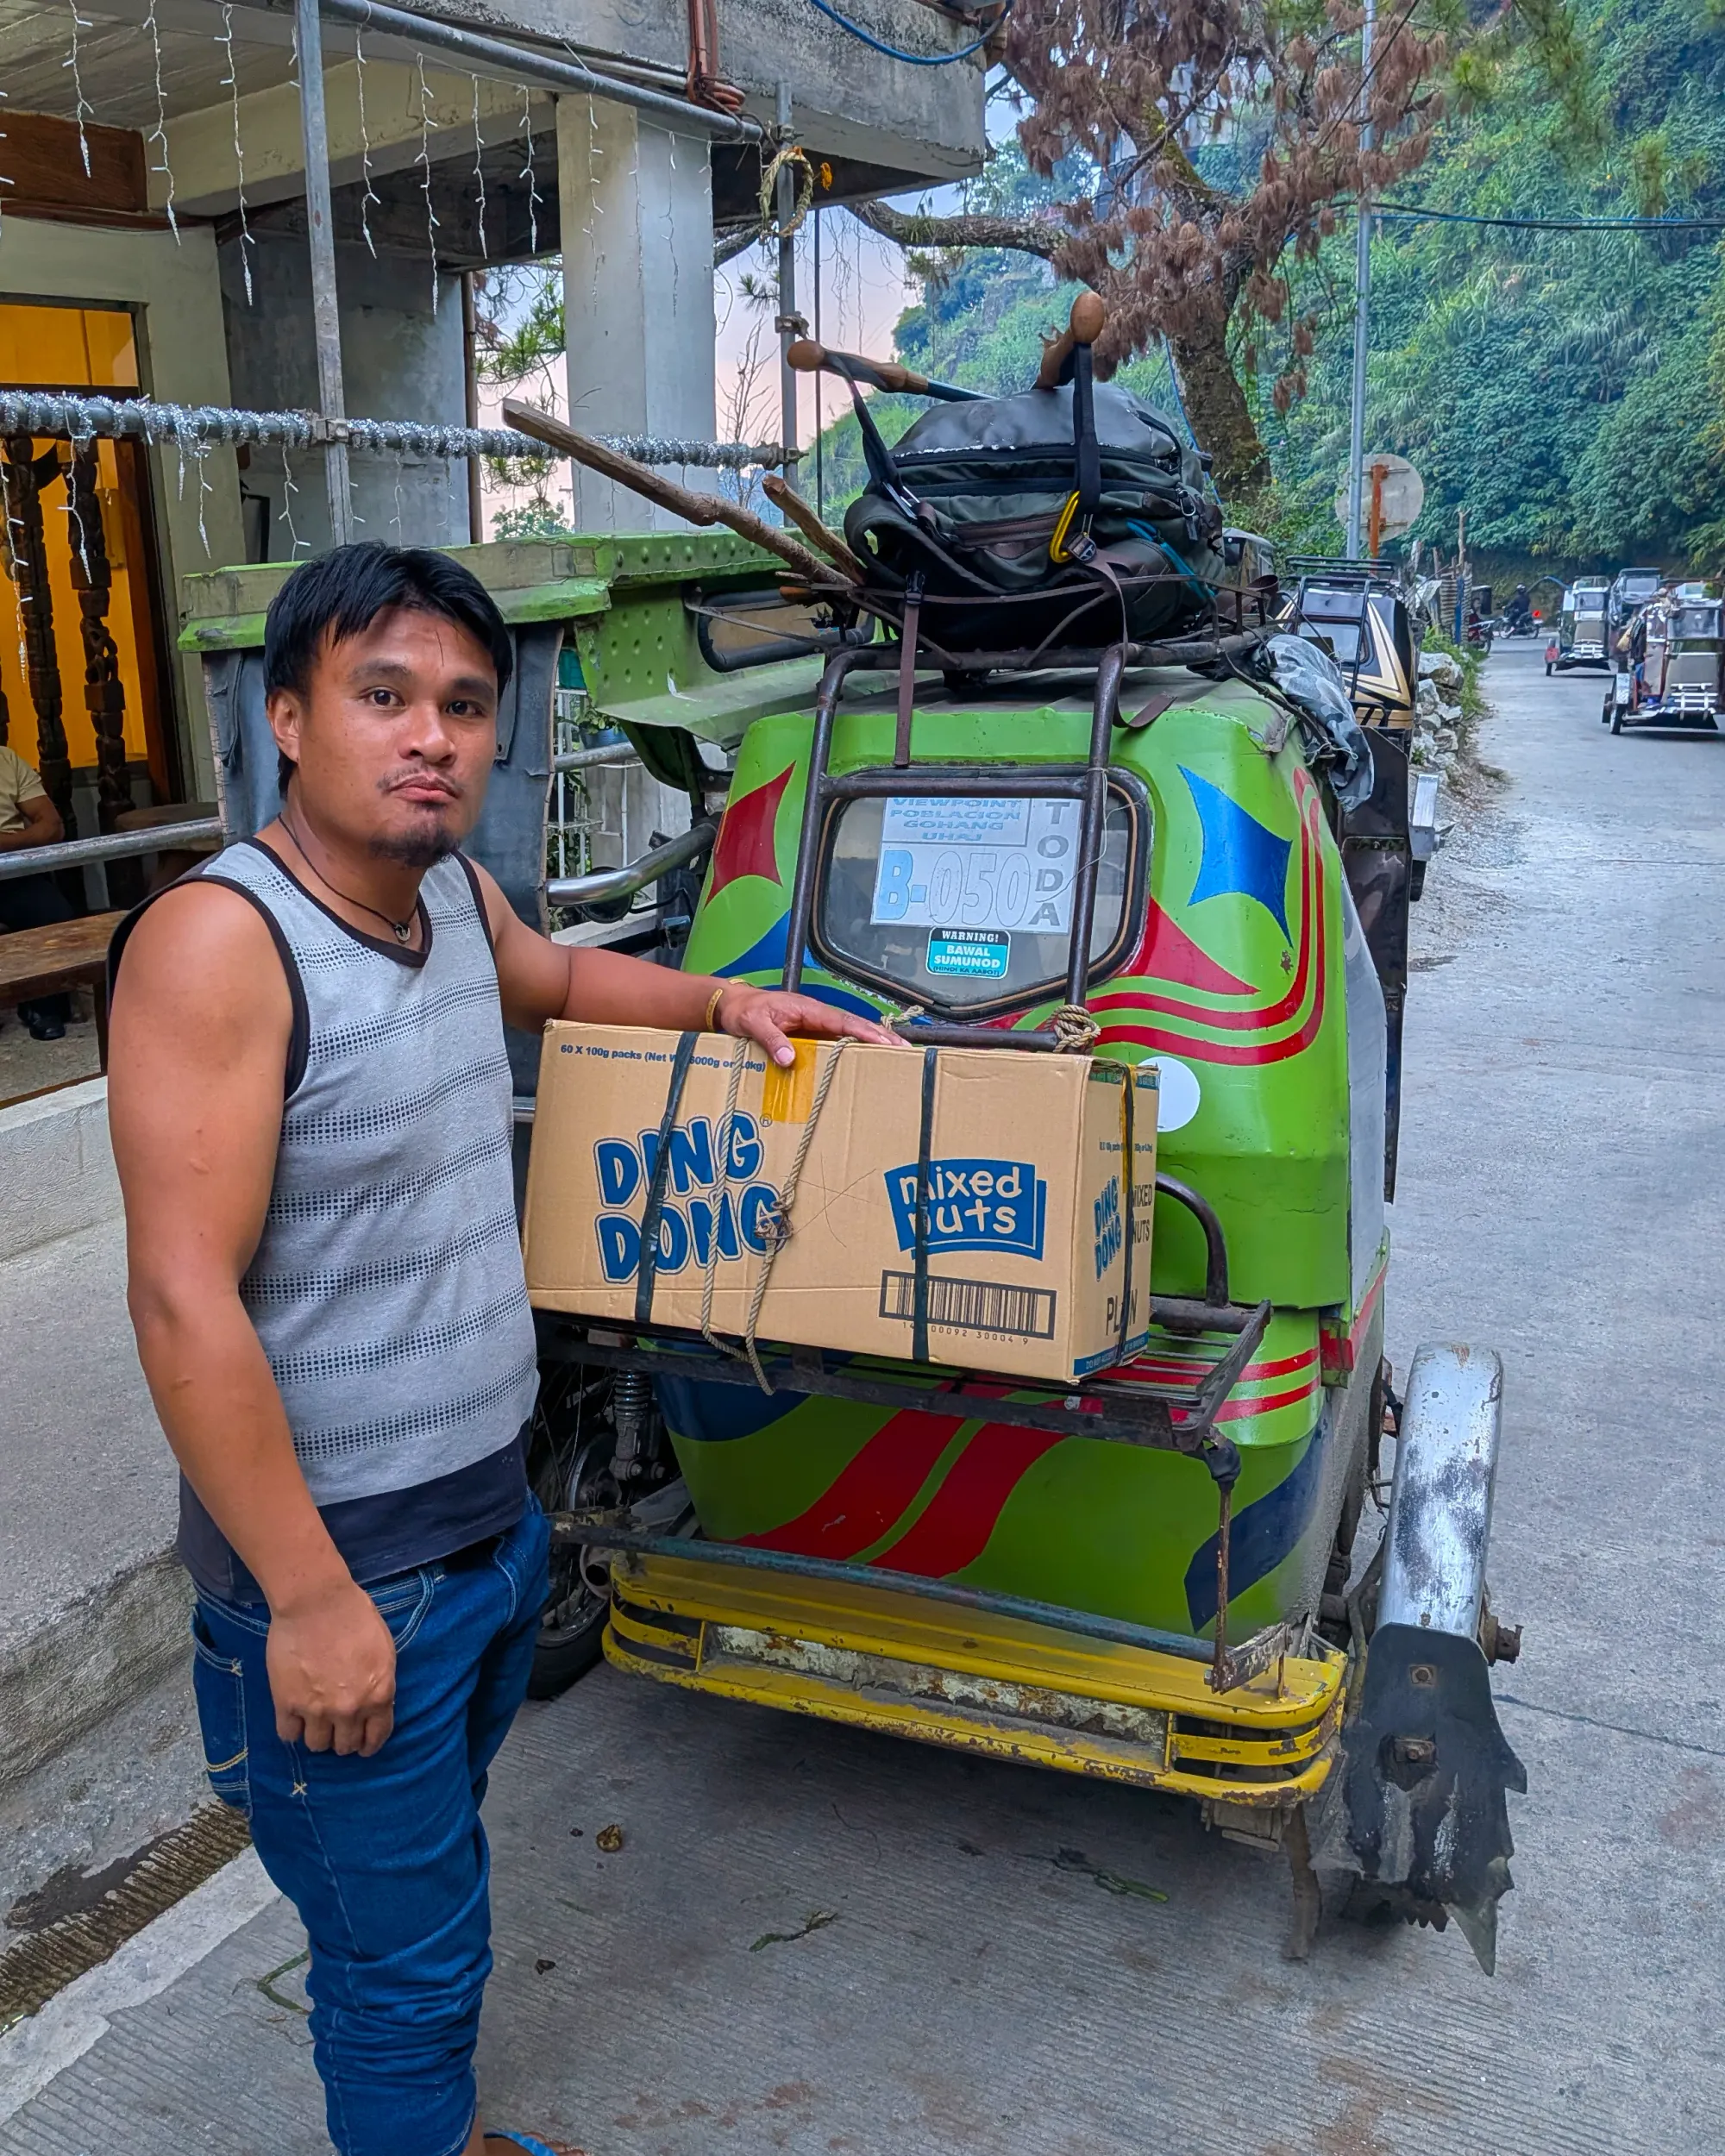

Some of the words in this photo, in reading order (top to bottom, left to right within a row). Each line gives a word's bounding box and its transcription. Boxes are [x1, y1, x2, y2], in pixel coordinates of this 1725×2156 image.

[893, 798, 1021, 808] VIEWPOINT
[889, 809, 1021, 820] POBLACION
[903, 820, 1004, 830] GOHANG
[1029, 801, 1070, 927] TODA
[875, 849, 1031, 928] B-050
[941, 931, 999, 943] WARNING!
[946, 944, 990, 956] BAWAL
[933, 955, 1000, 968] SUMUNOD
[561, 1044, 574, 1054] 60
[574, 1045, 583, 1055] X
[586, 1046, 610, 1059] 100g
[612, 1050, 643, 1060] packs
[644, 1051, 666, 1062] (Net
[593, 1110, 764, 1209] DING
[899, 1165, 1023, 1206] mixed
[1094, 1175, 1119, 1240] DING
[594, 1181, 787, 1284] DONG
[1095, 1212, 1121, 1282] DONG
[931, 1325, 968, 1338] 00092
[975, 1331, 1014, 1344] 30004
[1022, 1337, 1029, 1345] 9
